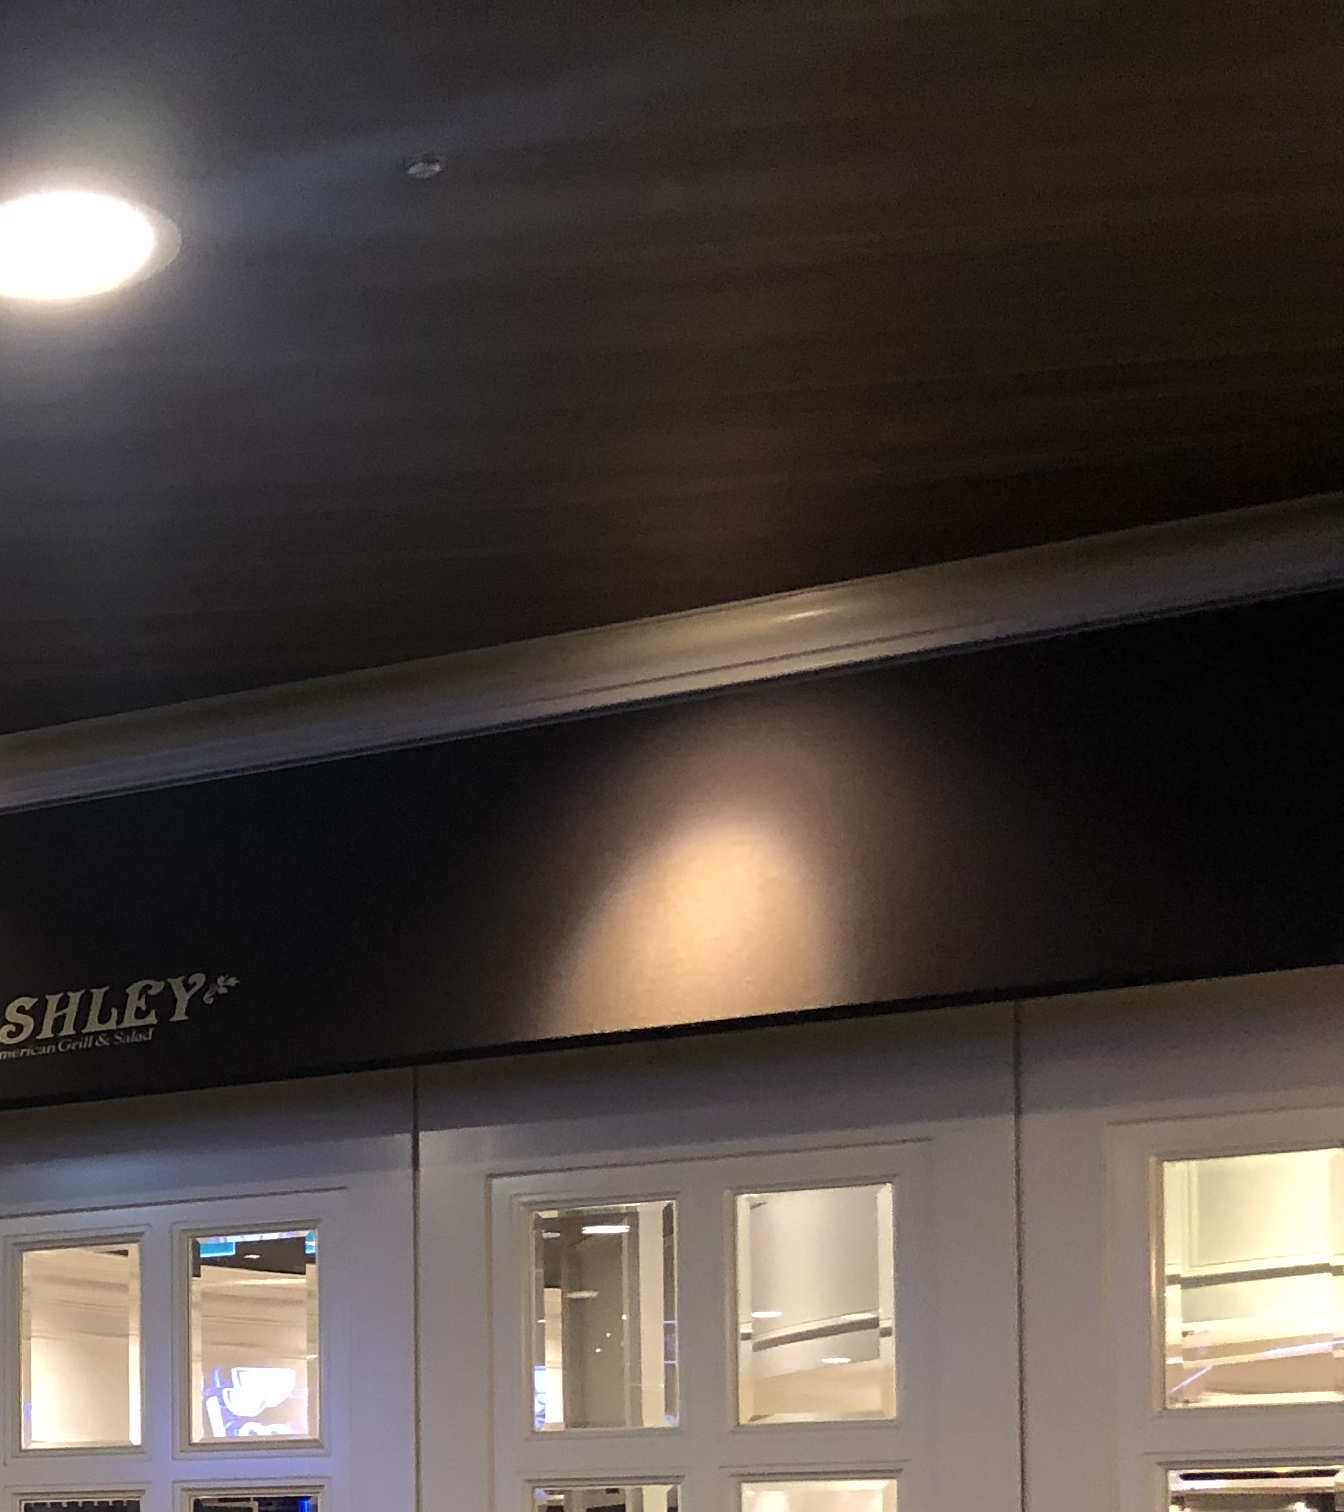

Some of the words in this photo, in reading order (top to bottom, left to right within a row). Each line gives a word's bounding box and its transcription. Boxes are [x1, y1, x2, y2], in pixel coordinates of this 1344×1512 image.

[57, 1034, 94, 1053] Grill
[95, 1033, 111, 1048] &
[113, 1027, 154, 1046] Salad
